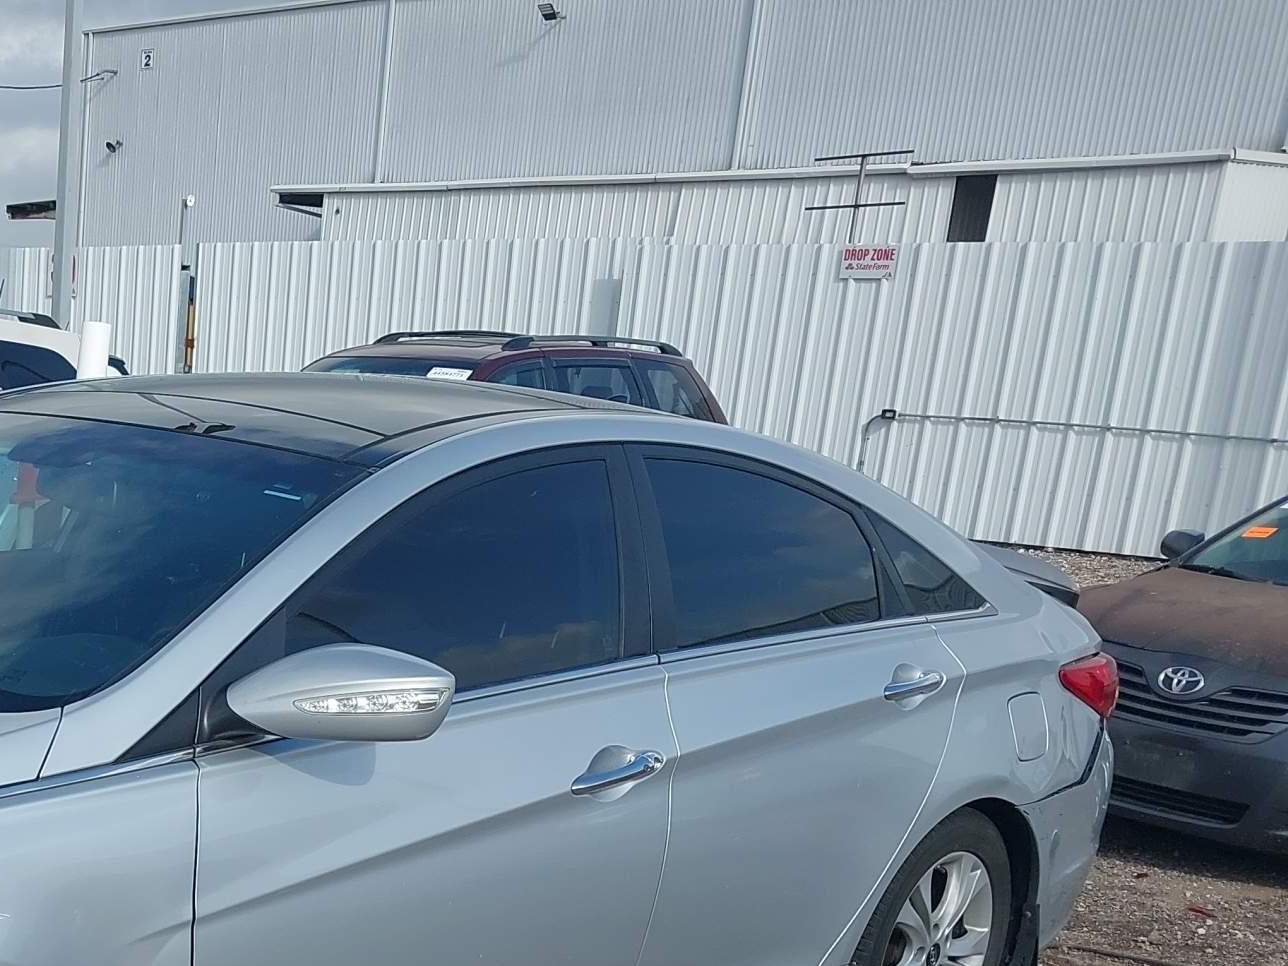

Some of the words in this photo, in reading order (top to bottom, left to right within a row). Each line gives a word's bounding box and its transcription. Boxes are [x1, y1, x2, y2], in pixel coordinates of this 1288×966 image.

[144, 54, 151, 67] 2
[844, 248, 870, 261] DROP
[871, 248, 896, 261] ZONE
